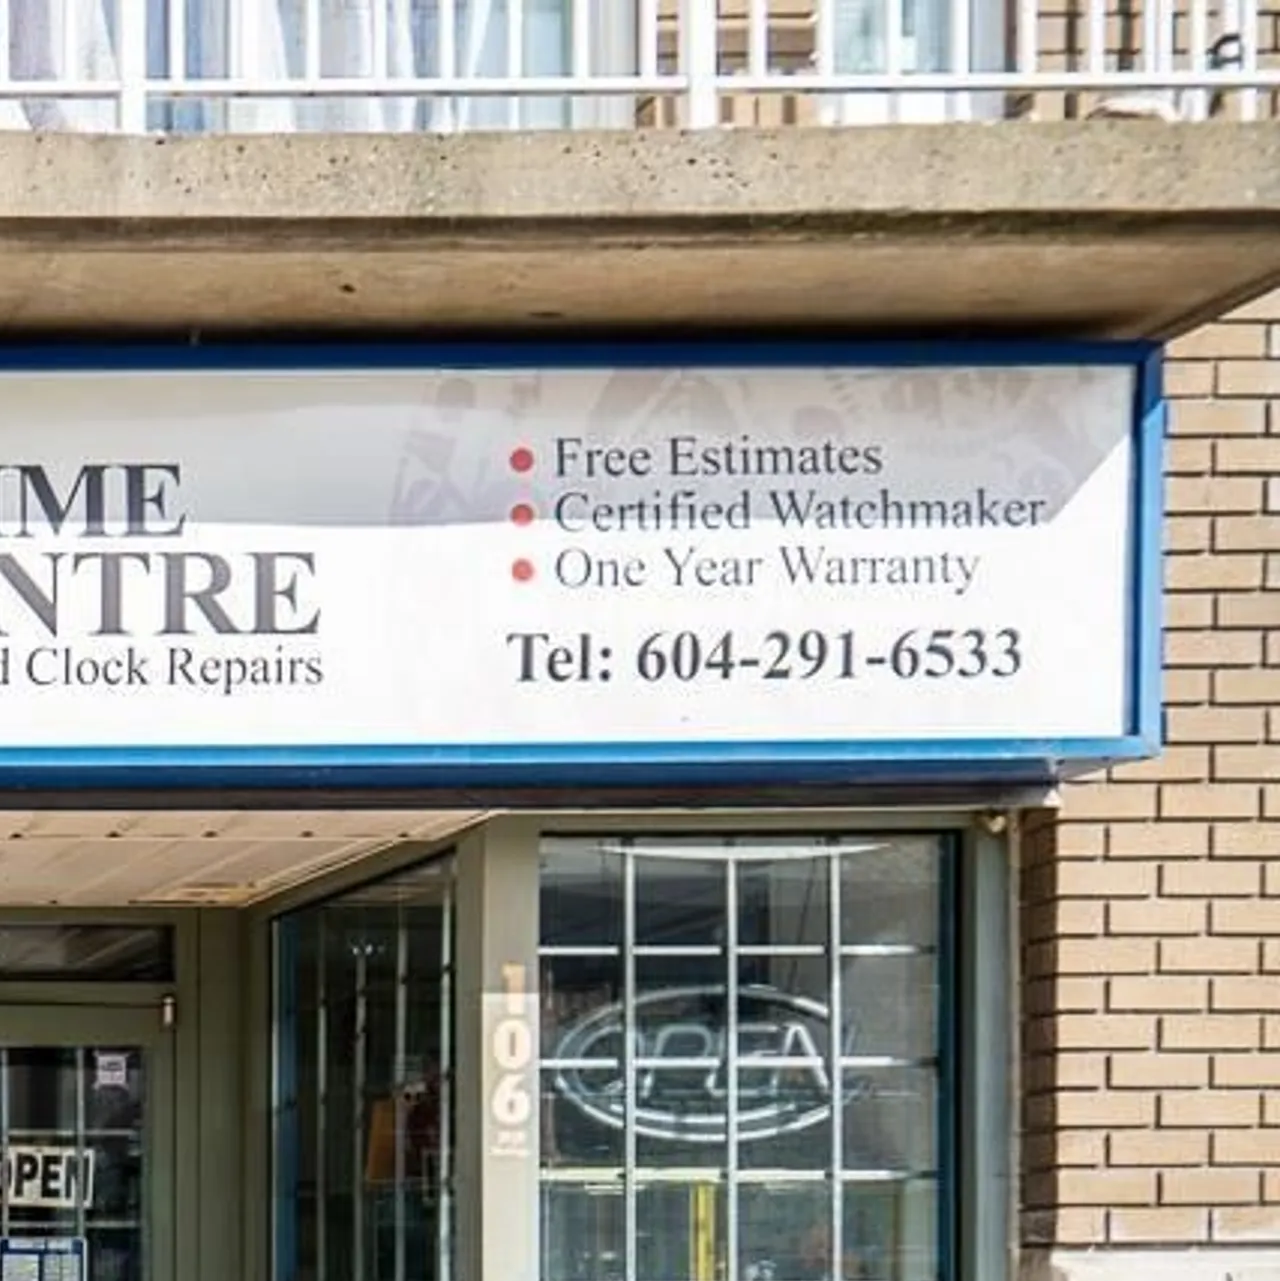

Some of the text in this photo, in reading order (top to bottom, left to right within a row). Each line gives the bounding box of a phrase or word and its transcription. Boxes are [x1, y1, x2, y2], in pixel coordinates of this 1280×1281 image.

[553, 435, 884, 477] Free Estimates
[553, 489, 1046, 532] Certified Watchmaker
[553, 545, 982, 595] One Year Warranty
[25, 646, 149, 687] Clock
[166, 646, 324, 696] Repairs
[507, 628, 1024, 682] Tel: 604-291-6533
[493, 962, 531, 1126] 106
